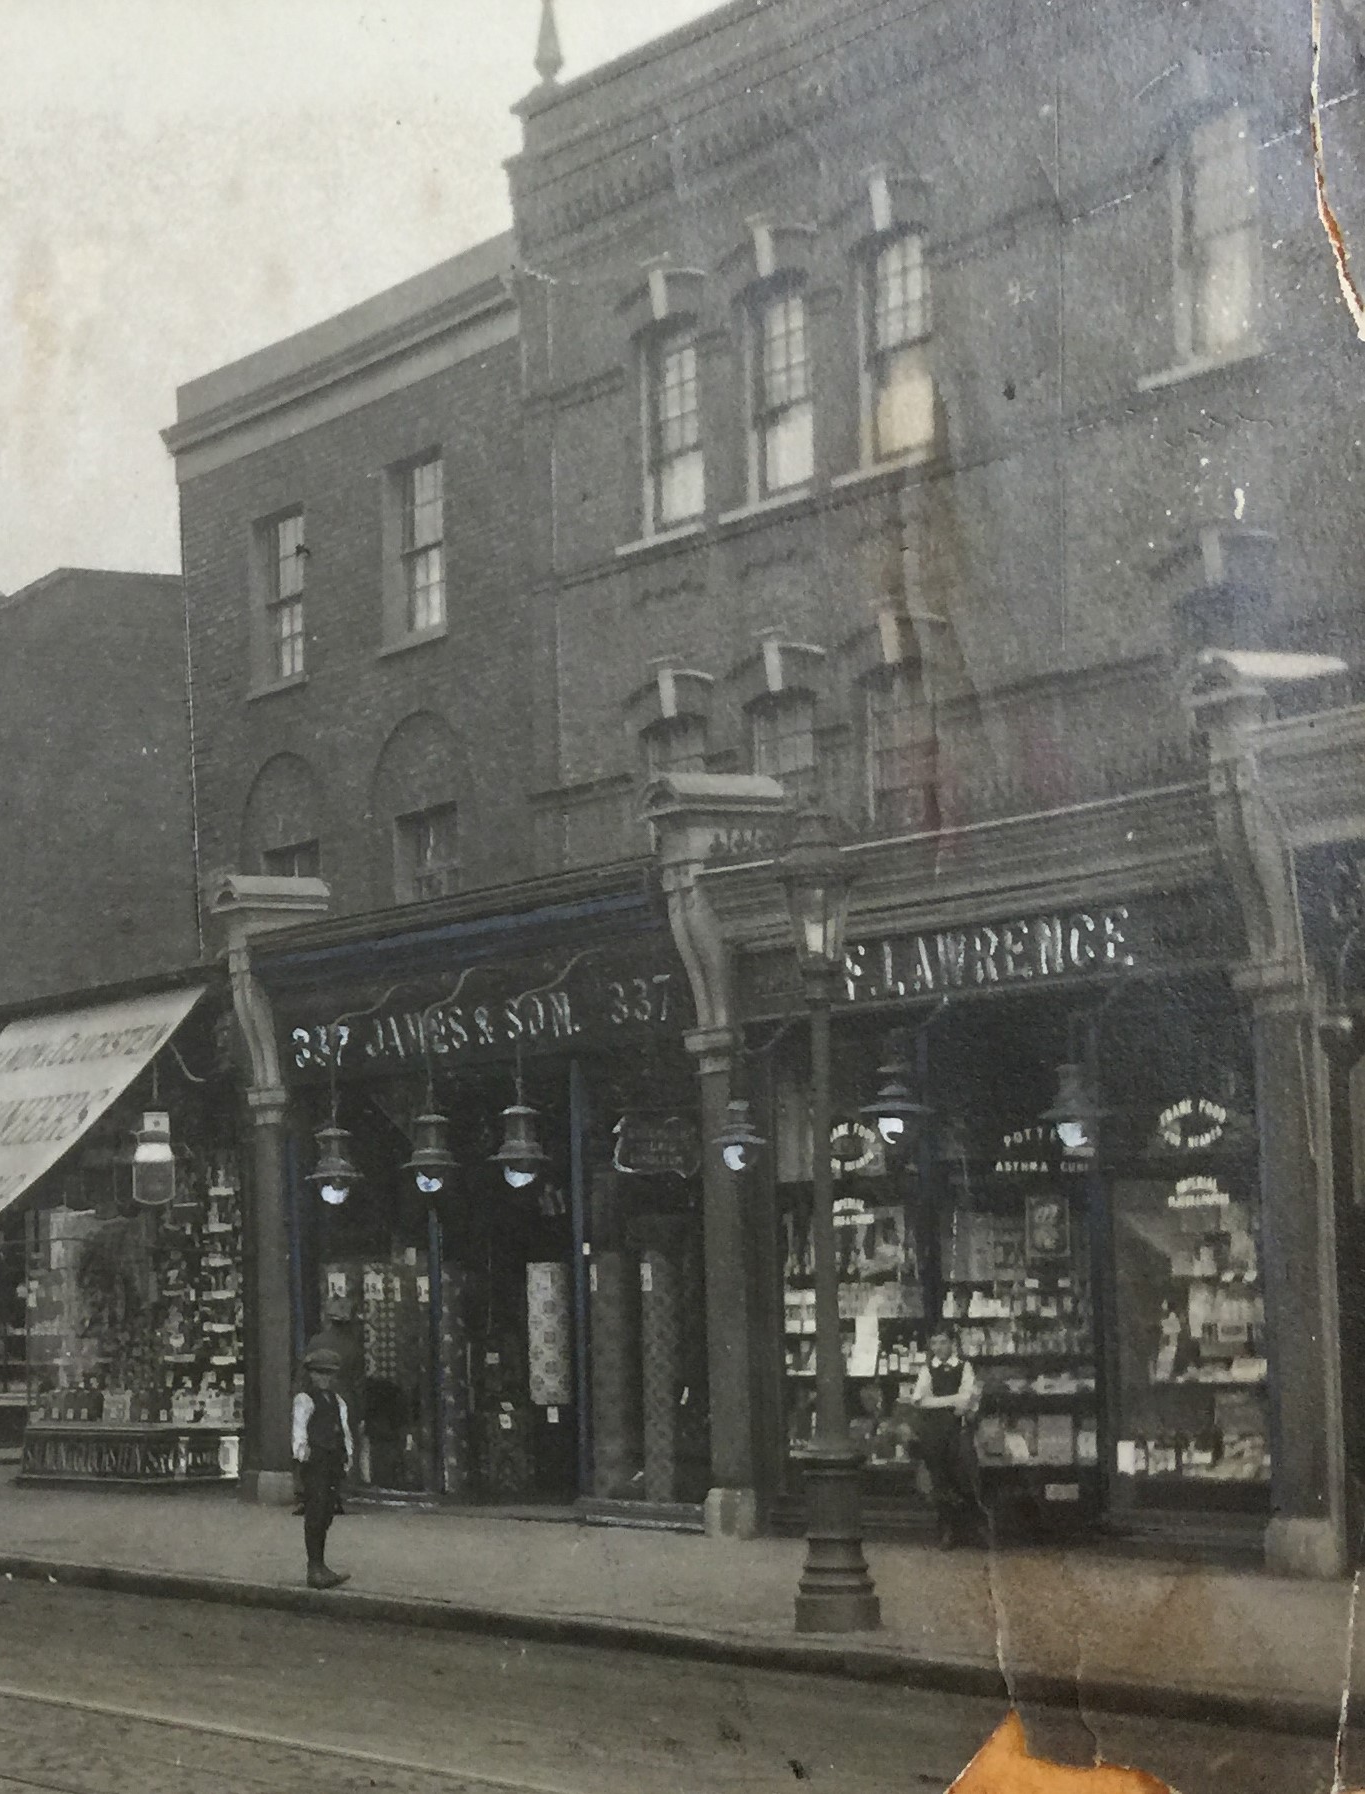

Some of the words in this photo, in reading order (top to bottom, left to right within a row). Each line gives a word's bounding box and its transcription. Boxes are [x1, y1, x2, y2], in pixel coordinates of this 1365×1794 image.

[882, 907, 1134, 996] LAWRENCE
[365, 1006, 469, 1059] JAMES
[474, 1006, 495, 1045] &
[609, 974, 671, 1025] 337
[995, 1160, 1049, 1172] ASTHMA
